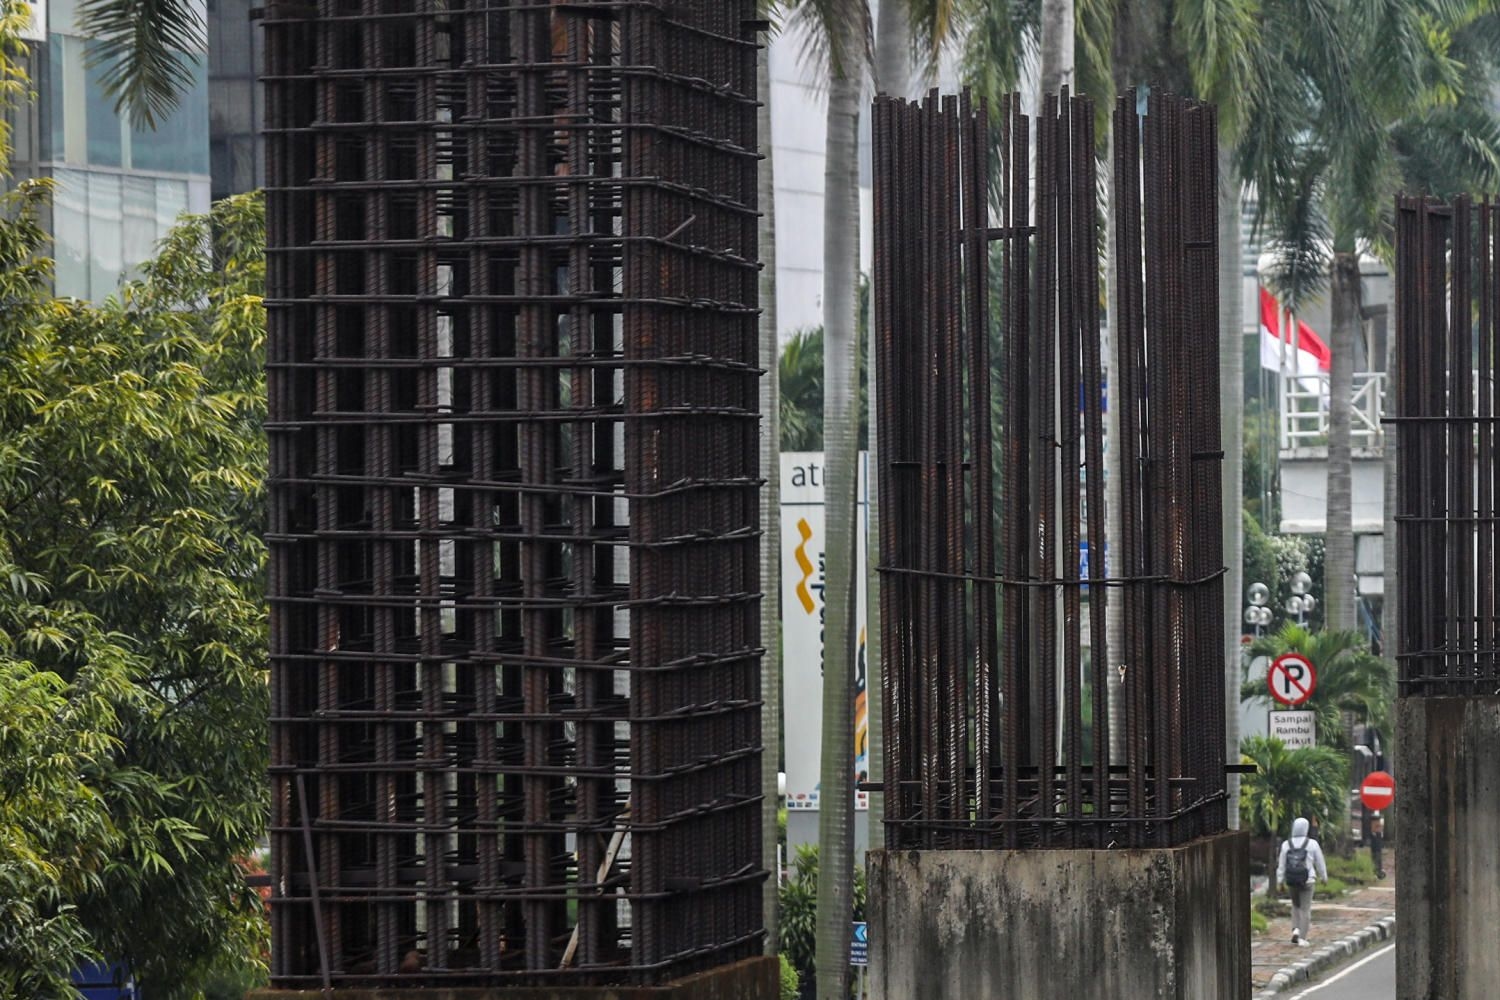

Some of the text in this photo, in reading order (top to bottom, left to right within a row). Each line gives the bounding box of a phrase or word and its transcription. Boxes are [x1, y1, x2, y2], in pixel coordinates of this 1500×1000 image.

[791, 462, 826, 487] at
[1274, 715, 1312, 725] Sampai
[1276, 726, 1310, 735] Rambu
[1282, 736, 1312, 745] erikut
